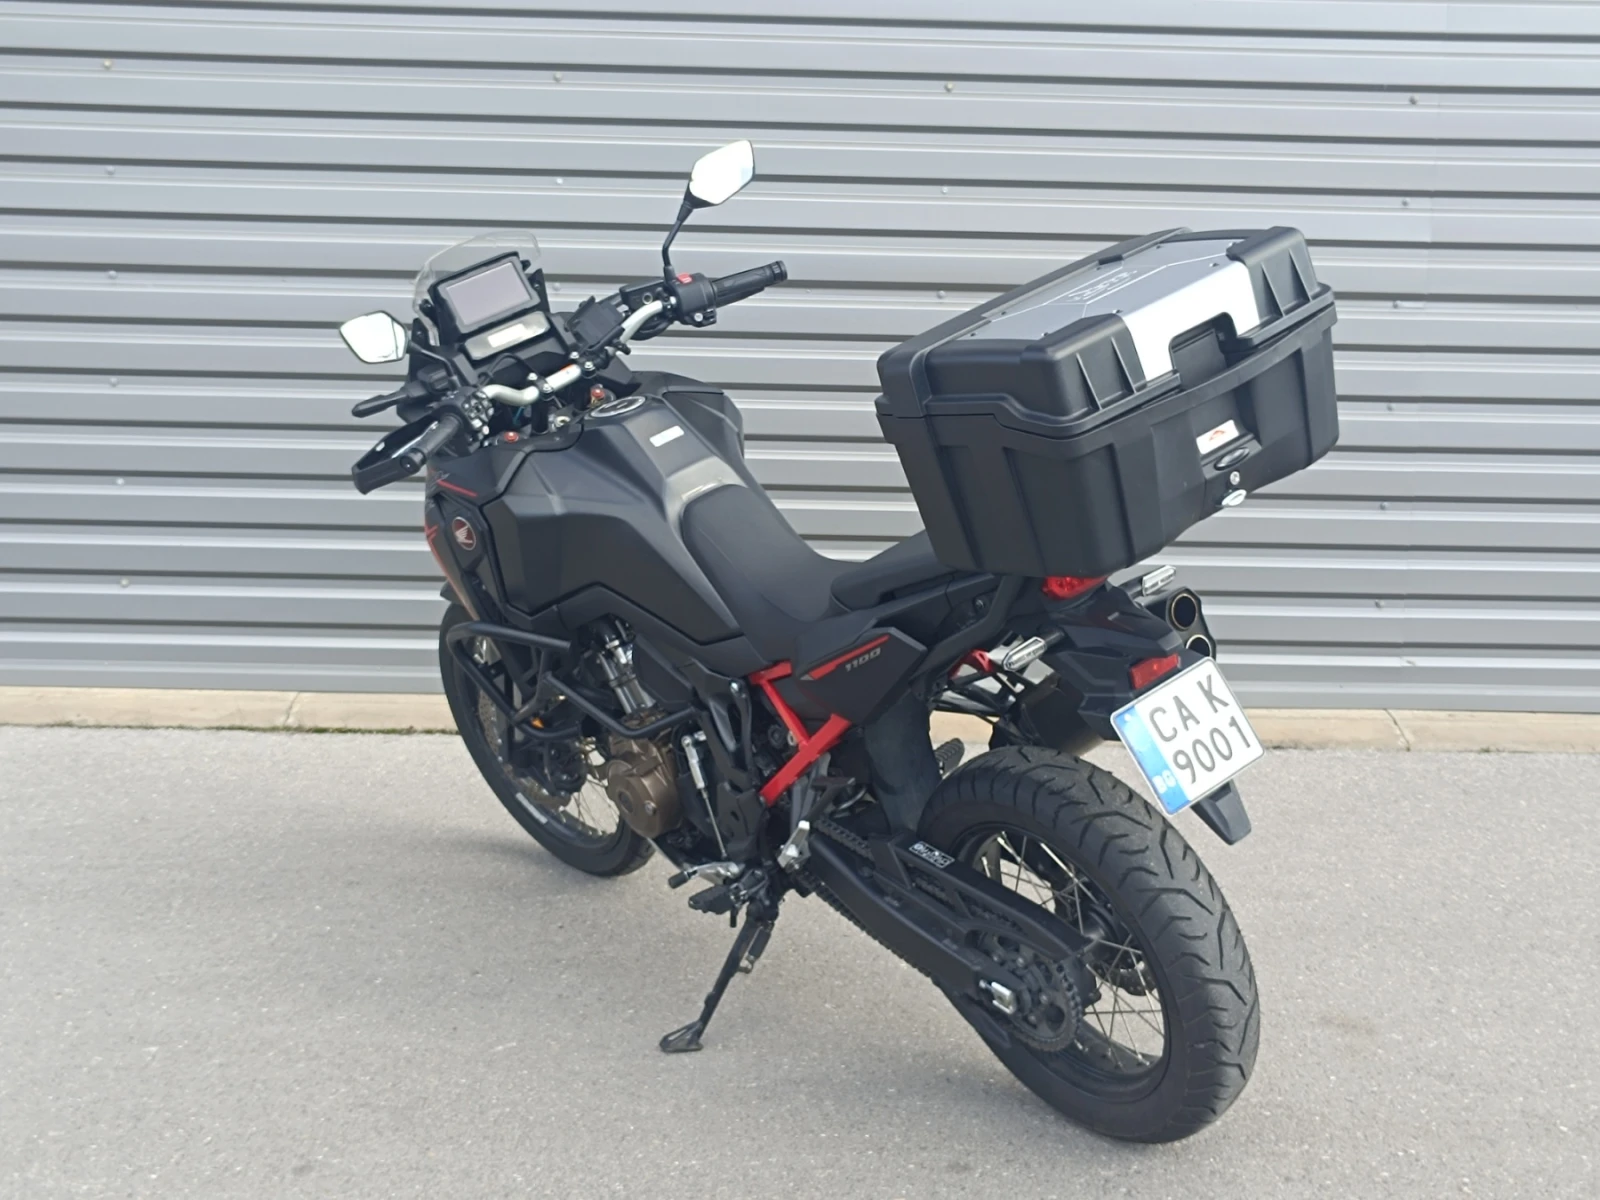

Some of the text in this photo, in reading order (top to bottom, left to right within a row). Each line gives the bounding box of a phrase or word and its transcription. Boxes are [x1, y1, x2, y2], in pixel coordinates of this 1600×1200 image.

[845, 647, 881, 671] 1100
[1149, 674, 1229, 742] CA K
[1172, 715, 1251, 784] 9001
[1152, 769, 1177, 794] BG
